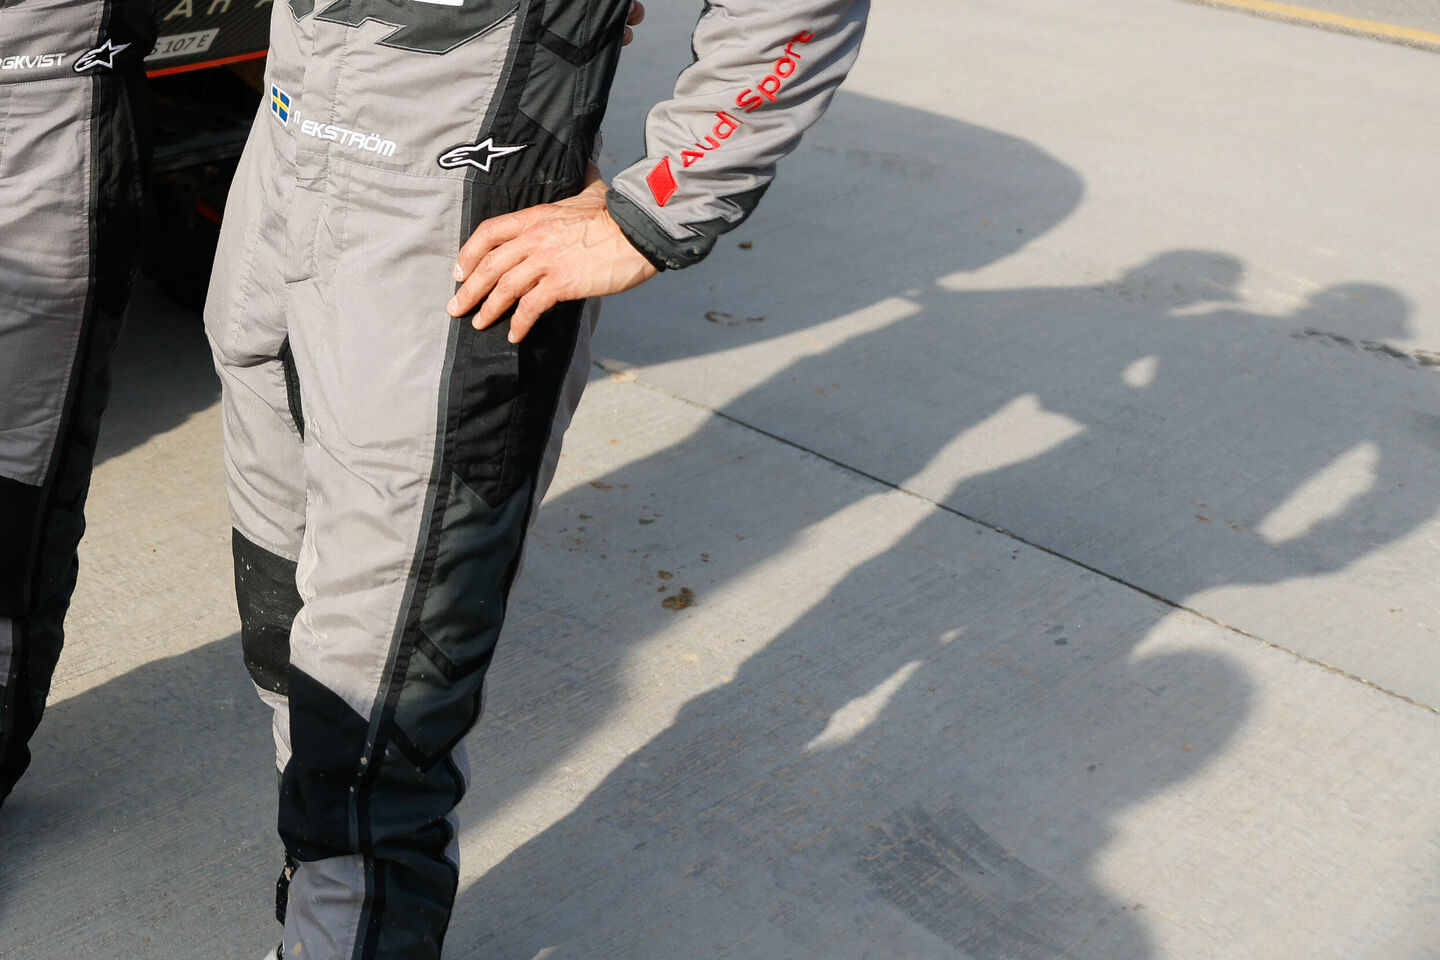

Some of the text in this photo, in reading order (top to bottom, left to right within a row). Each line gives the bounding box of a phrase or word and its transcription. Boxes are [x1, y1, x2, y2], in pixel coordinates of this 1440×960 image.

[301, 119, 397, 157] EKSTRÖM
[681, 29, 815, 168] Audi Sport
